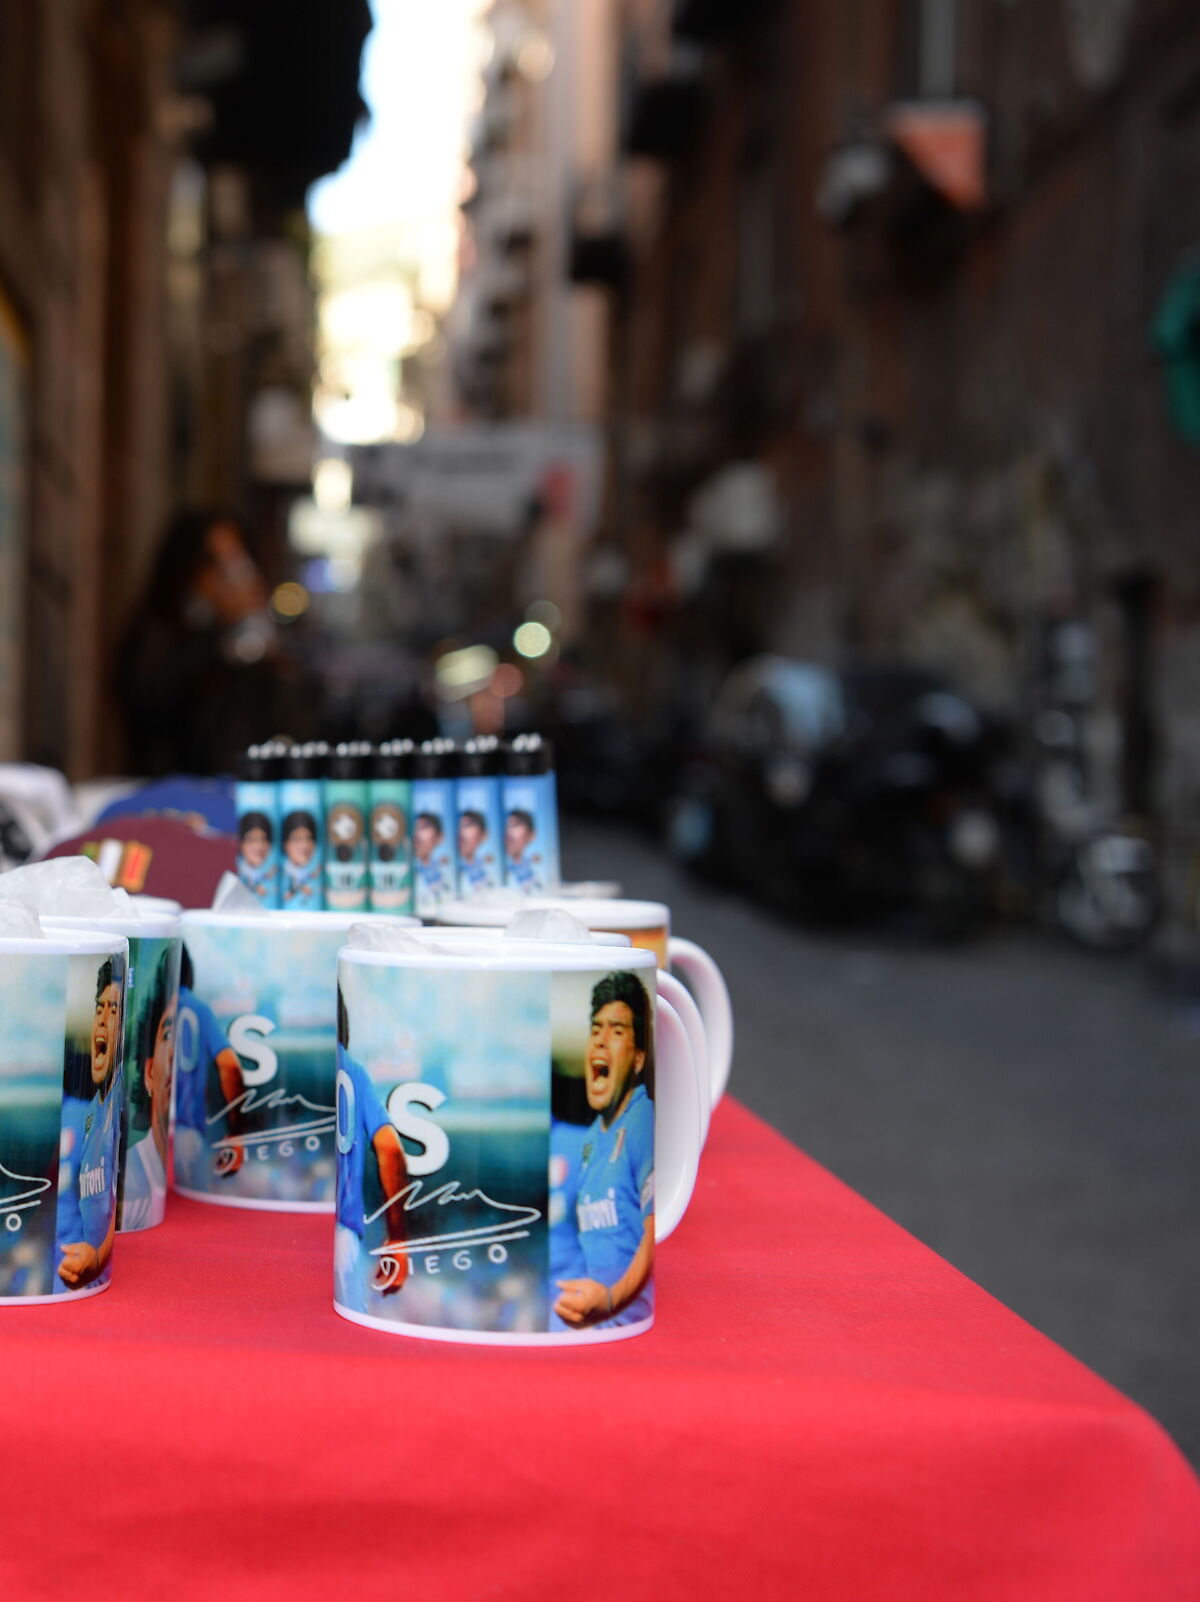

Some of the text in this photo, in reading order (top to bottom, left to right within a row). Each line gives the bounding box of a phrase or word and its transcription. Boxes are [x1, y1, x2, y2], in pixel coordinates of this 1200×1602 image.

[229, 1014, 278, 1087] S
[387, 1082, 450, 1176] S
[371, 1243, 509, 1291] DIEGO
